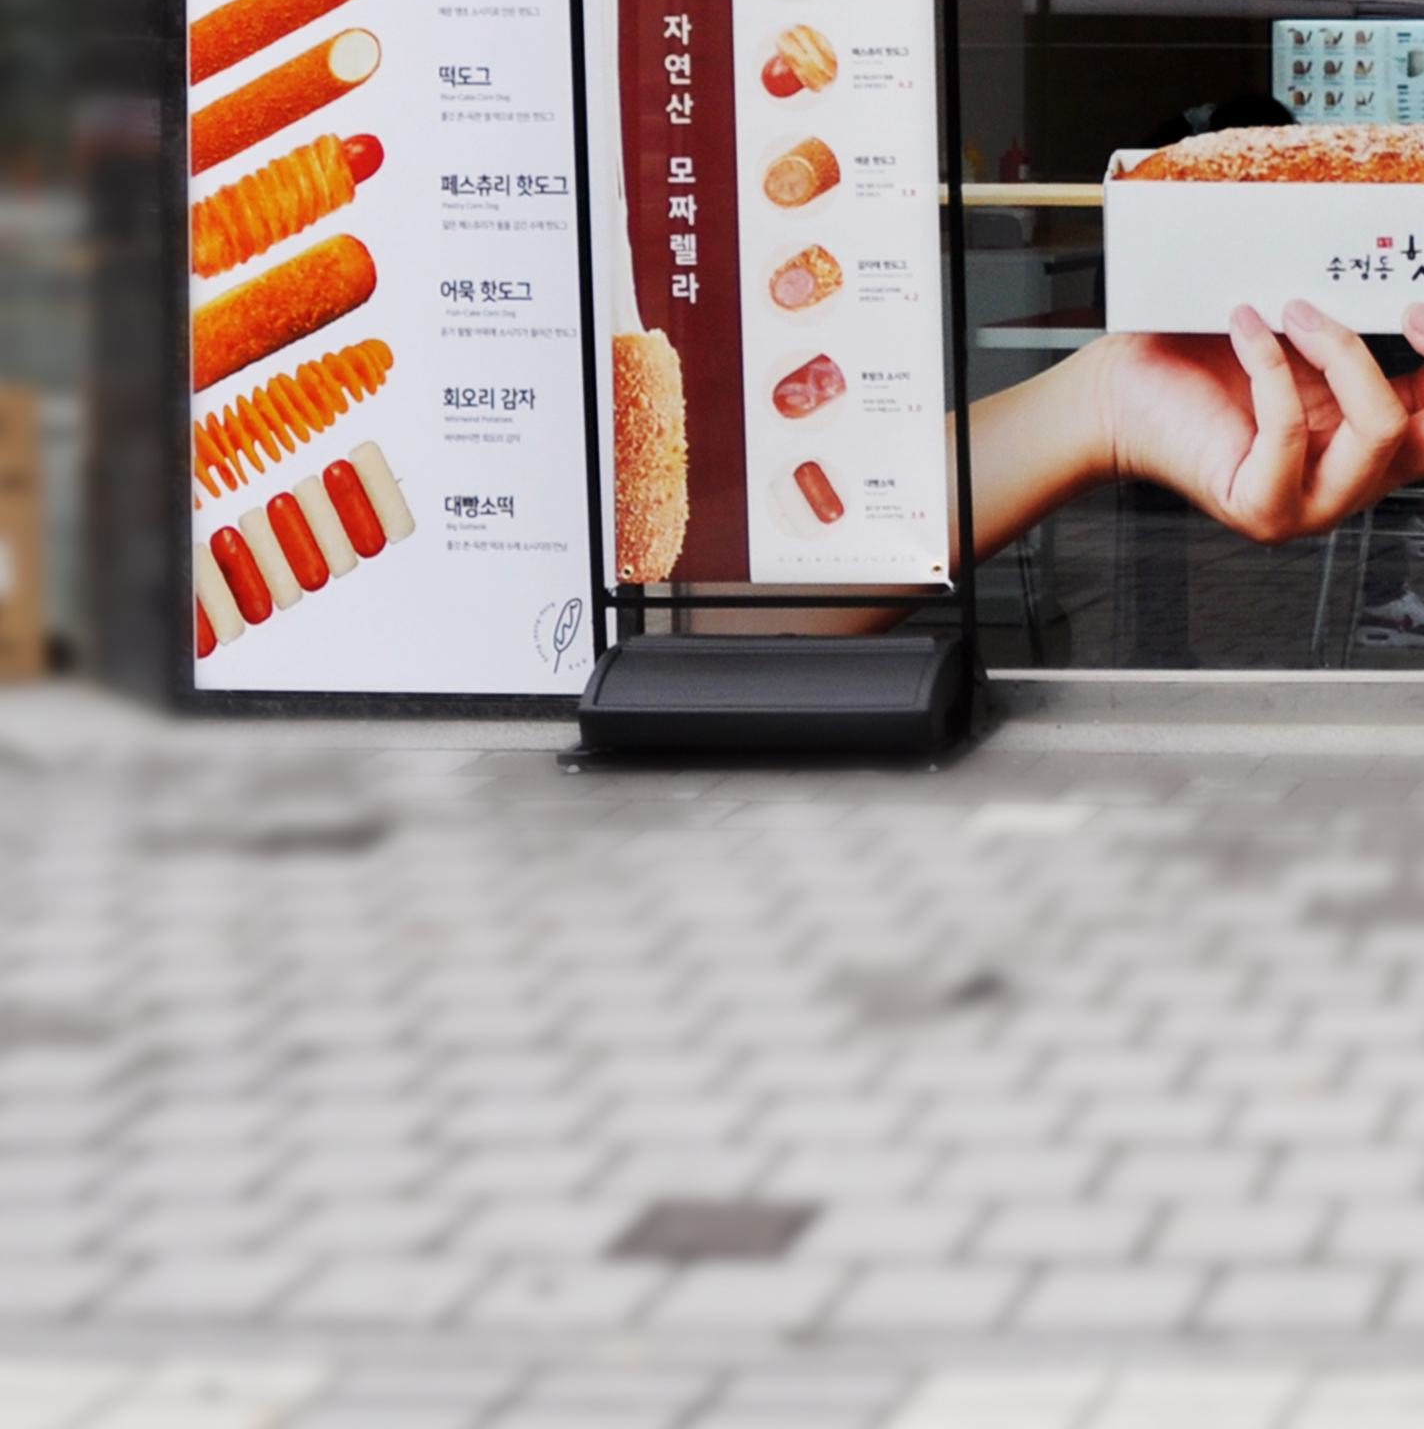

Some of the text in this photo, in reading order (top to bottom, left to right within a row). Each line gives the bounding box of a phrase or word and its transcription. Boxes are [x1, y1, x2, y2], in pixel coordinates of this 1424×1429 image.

[439, 66, 492, 88] 떡도그
[664, 14, 699, 304] 자연산 모짜렐라
[440, 174, 569, 197] 페스츄리 핫도그
[1326, 255, 1394, 280] 송정동
[440, 280, 533, 302] 어묵 핫도그
[443, 387, 536, 410] 회오리 감자
[444, 495, 514, 518] 대빵소떡
